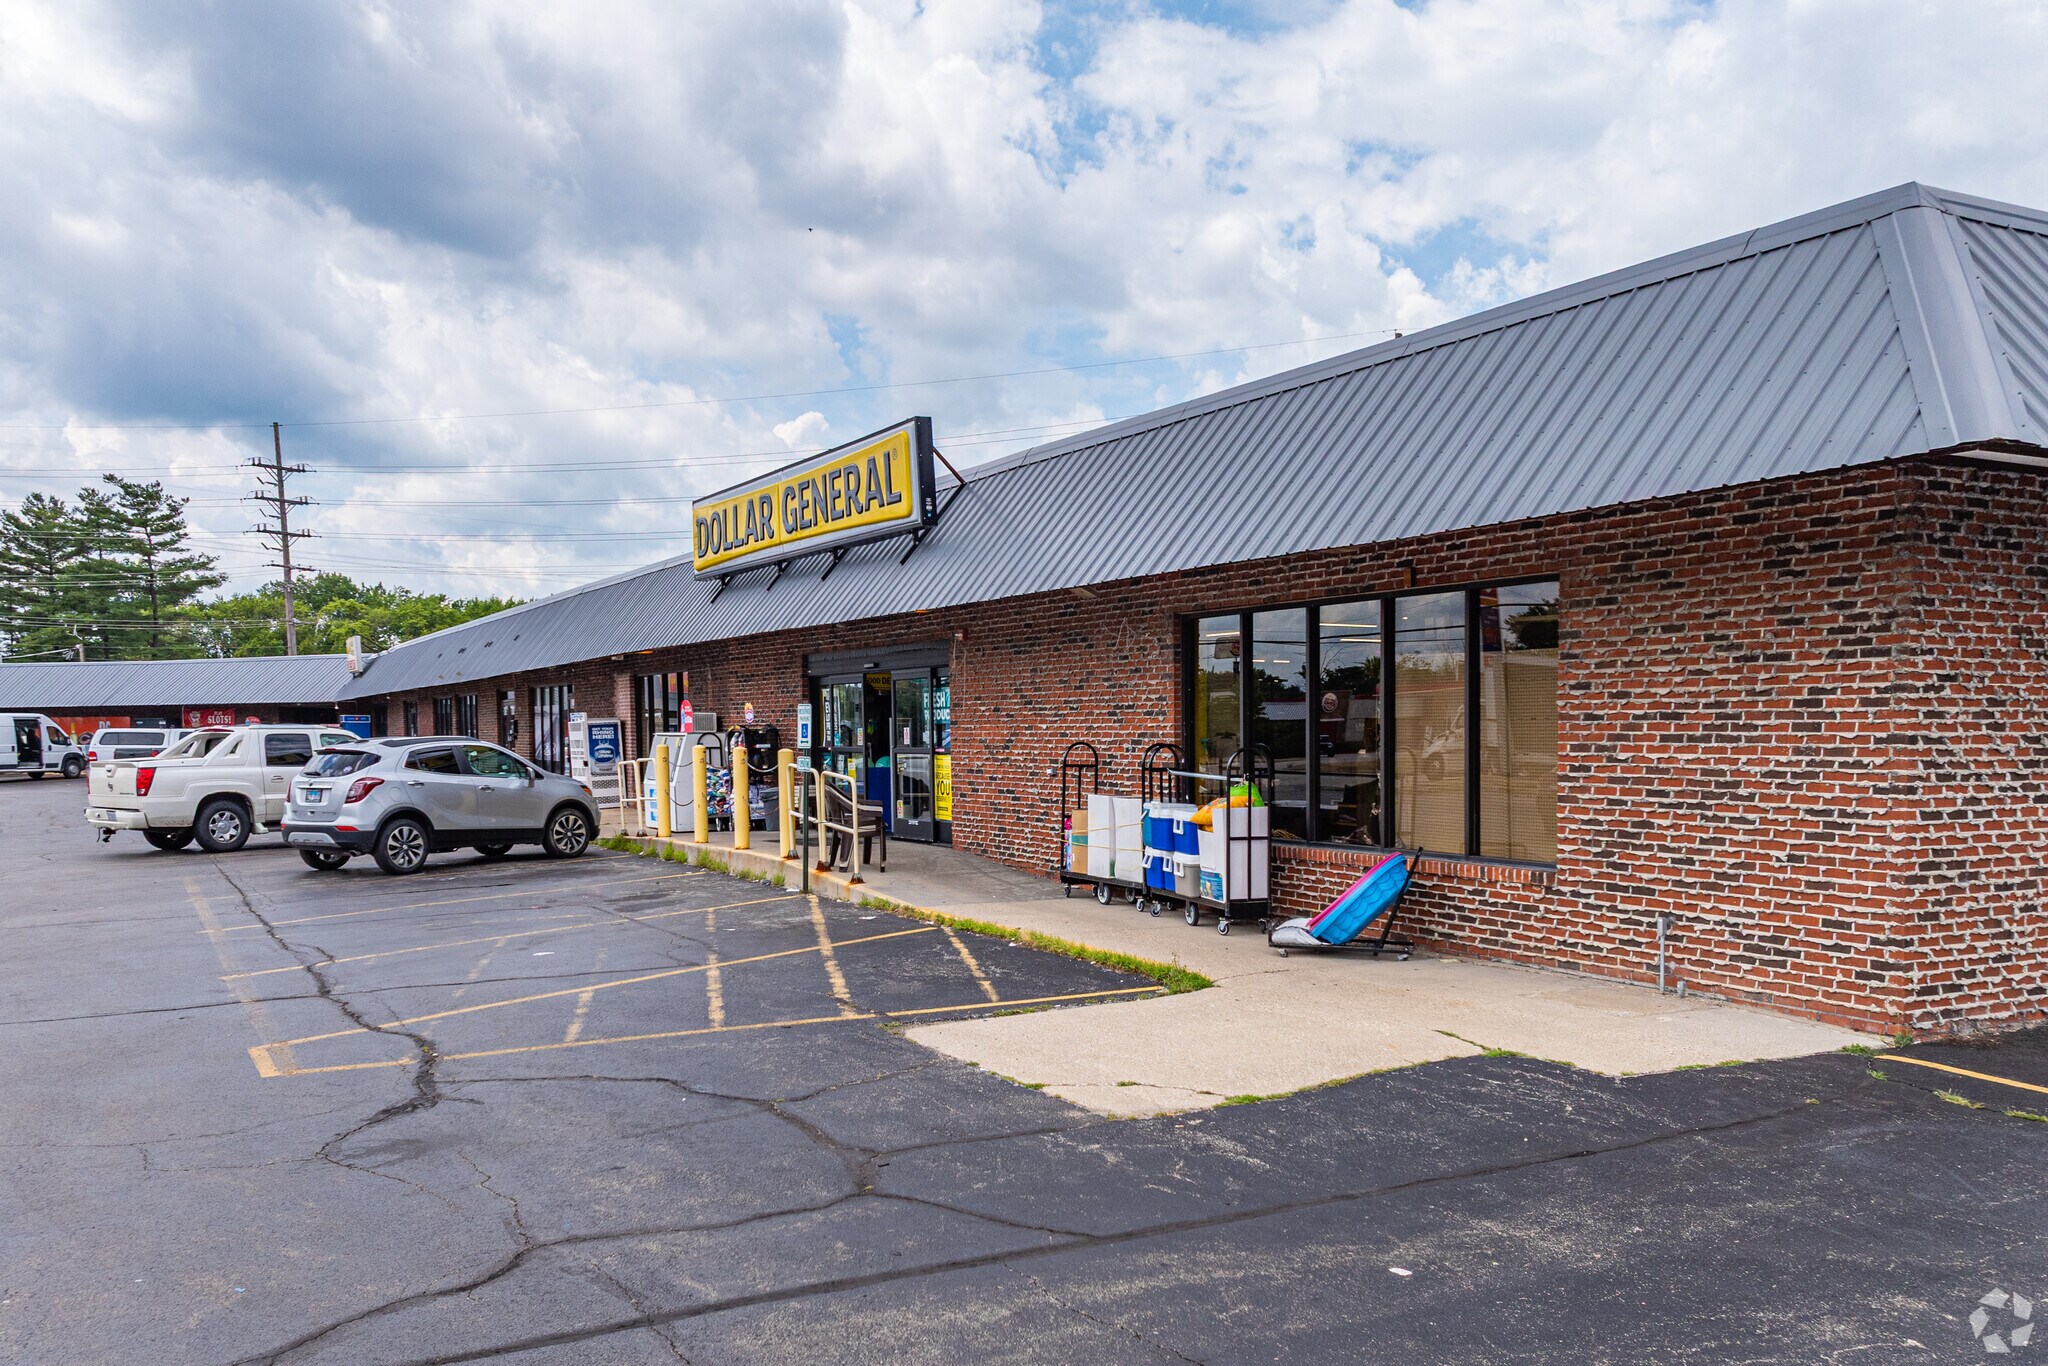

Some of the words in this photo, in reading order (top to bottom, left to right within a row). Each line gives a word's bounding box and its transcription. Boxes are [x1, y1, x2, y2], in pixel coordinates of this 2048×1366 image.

[696, 493, 774, 558] DOLLAR
[782, 451, 902, 534] GENERAL
[923, 691, 946, 708] FESH
[207, 715, 232, 724] SLOTS!
[936, 780, 950, 796] YOU
